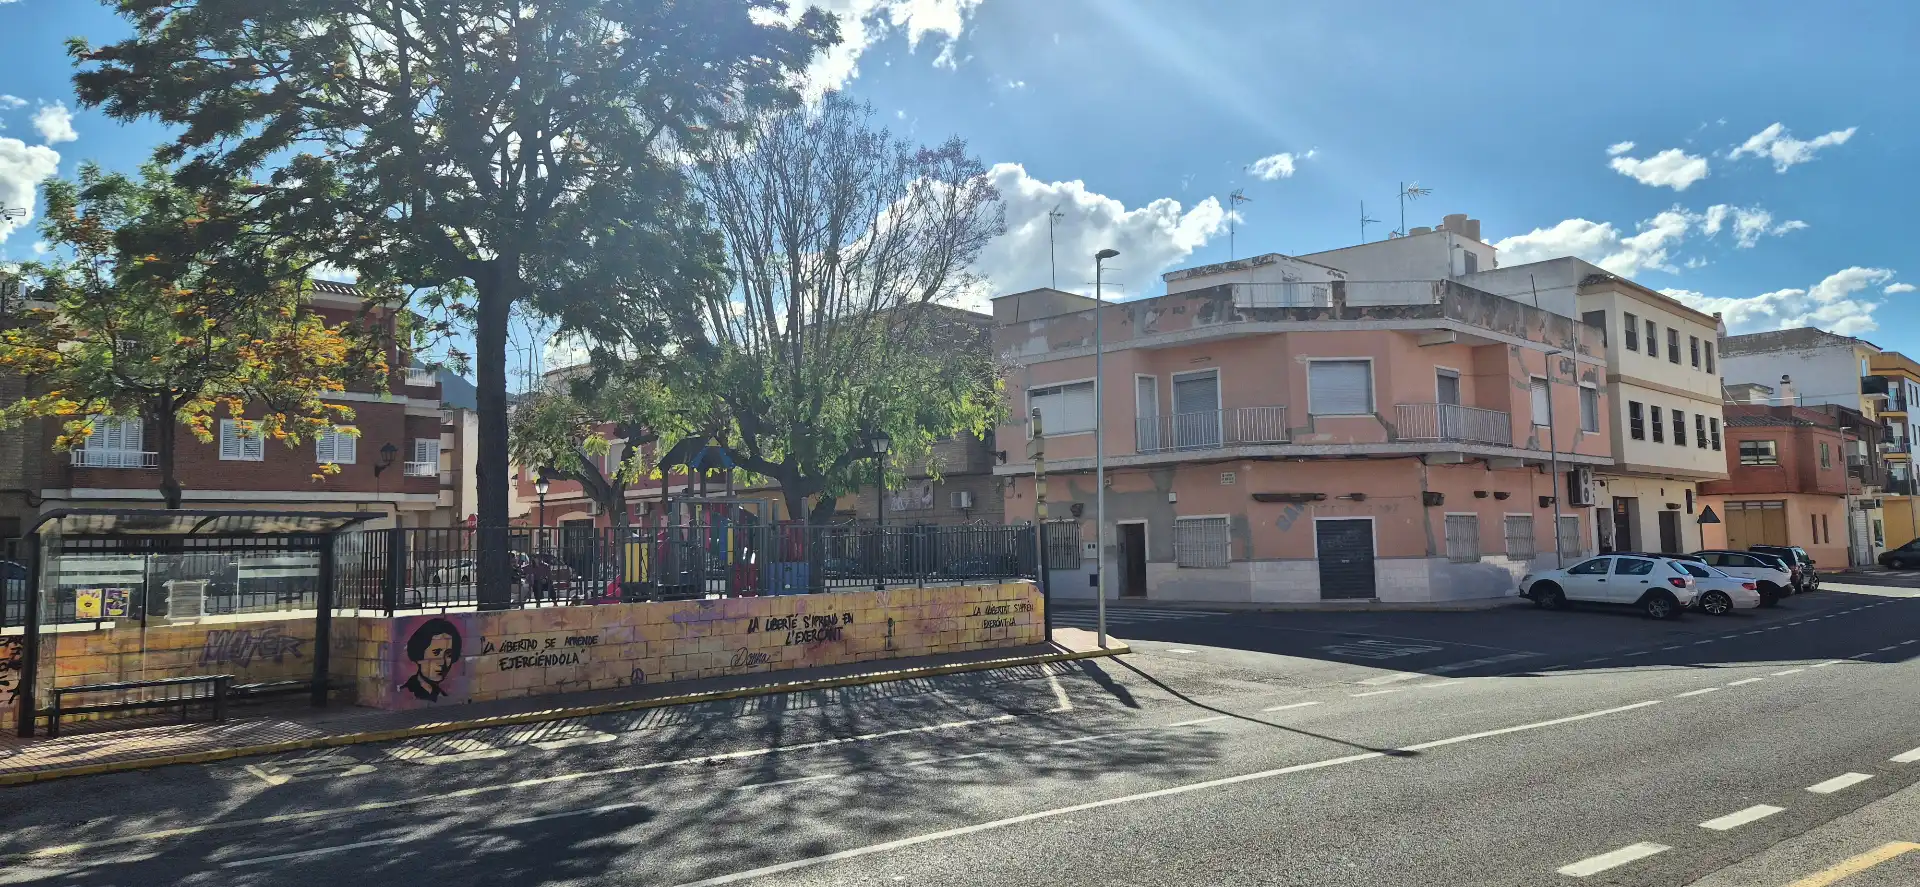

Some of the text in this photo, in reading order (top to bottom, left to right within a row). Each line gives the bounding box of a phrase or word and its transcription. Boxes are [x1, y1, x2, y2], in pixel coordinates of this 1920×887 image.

[973, 605, 981, 616] LA
[747, 617, 759, 634] LA
[842, 613, 854, 626] EN
[499, 638, 538, 653] LIBERTAD
[544, 637, 556, 649] SE
[564, 636, 599, 647] APRENDE
